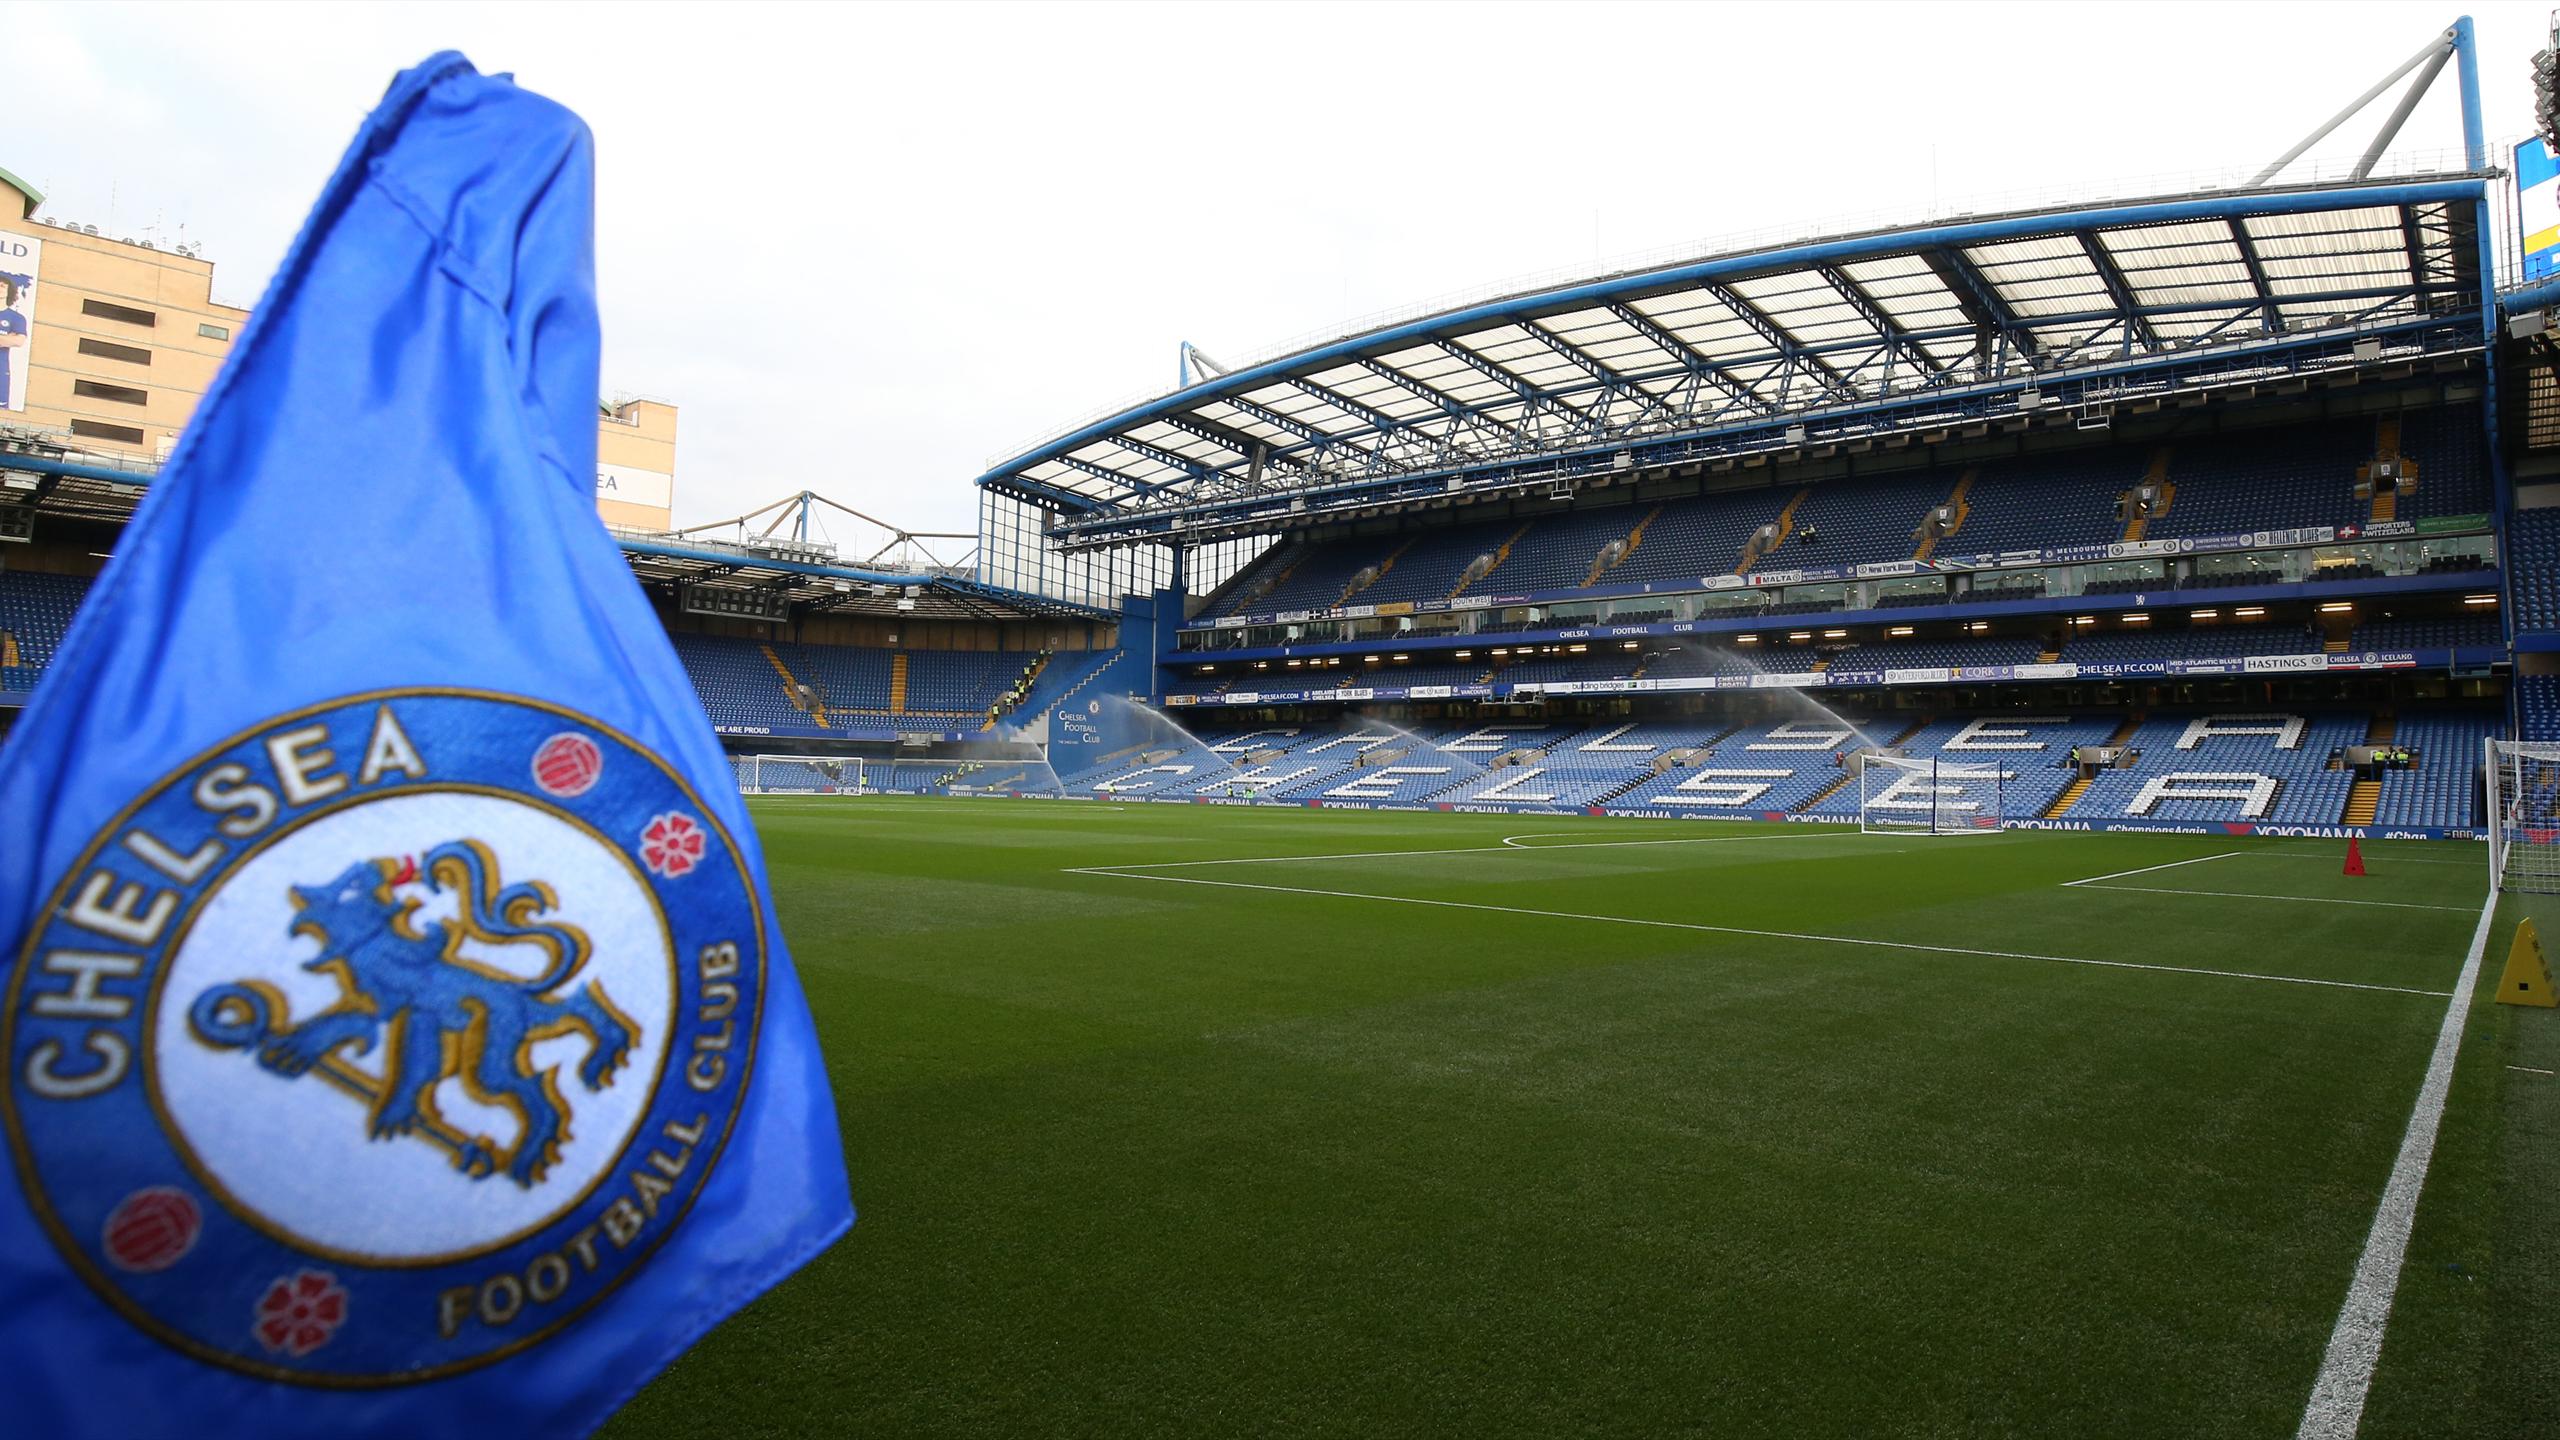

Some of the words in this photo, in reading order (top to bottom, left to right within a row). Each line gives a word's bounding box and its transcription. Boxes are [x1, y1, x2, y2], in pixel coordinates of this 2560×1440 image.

[2366, 521, 2410, 531] SUPPORTERS
[2269, 530, 2297, 545] HELLENIC
[2300, 528, 2319, 543] BLUES
[2362, 527, 2415, 538] SWITZERLAND
[2056, 544, 2107, 554] MELBOURNE
[2057, 553, 2108, 562] CHELSEA
[1762, 575, 1792, 583] MALTA
[1452, 597, 1473, 605] SOUTH
[1559, 629, 1589, 638] CHELSEA
[1612, 626, 1649, 635] FOOTBALL
[1673, 624, 1693, 632] CLUB
[2381, 653, 2413, 661] ICELAND
[2248, 658, 2307, 668] HASTINGS
[1966, 667, 1995, 677] CORK
[1572, 681, 1598, 690] buding
[1600, 680, 1625, 690] bridges
[1354, 688, 1368, 696] BLUES
[1461, 688, 1491, 696] VANCOUVER
[1059, 711, 1087, 722] CHELSEA
[714, 725, 727, 733] WE
[728, 726, 743, 734] ARE
[744, 726, 770, 735] PROUD
[1064, 722, 1097, 733] FOOTBALL
[1083, 733, 1101, 743] CLUB
[835, 786, 879, 795] YOKOHAMA
[1208, 798, 1251, 806] YOKOHAMA
[1322, 801, 1370, 810] YOKOHAMA
[1453, 805, 1509, 814] YOKOHAMA
[1606, 808, 1671, 819] YOKOHAMA
[1681, 813, 1752, 821] #ChampionsAgain
[1785, 813, 1861, 825] YOKOHAMA
[2001, 818, 2090, 831] YOKOHAMA
[2106, 824, 2207, 835] #ChampionsAgain
[2254, 825, 2367, 839] YOKOHAMA
[26, 703, 428, 1100] CHELSEA
[438, 1112, 709, 1340] FOOTBALL
[687, 939, 739, 1092] CLUB
